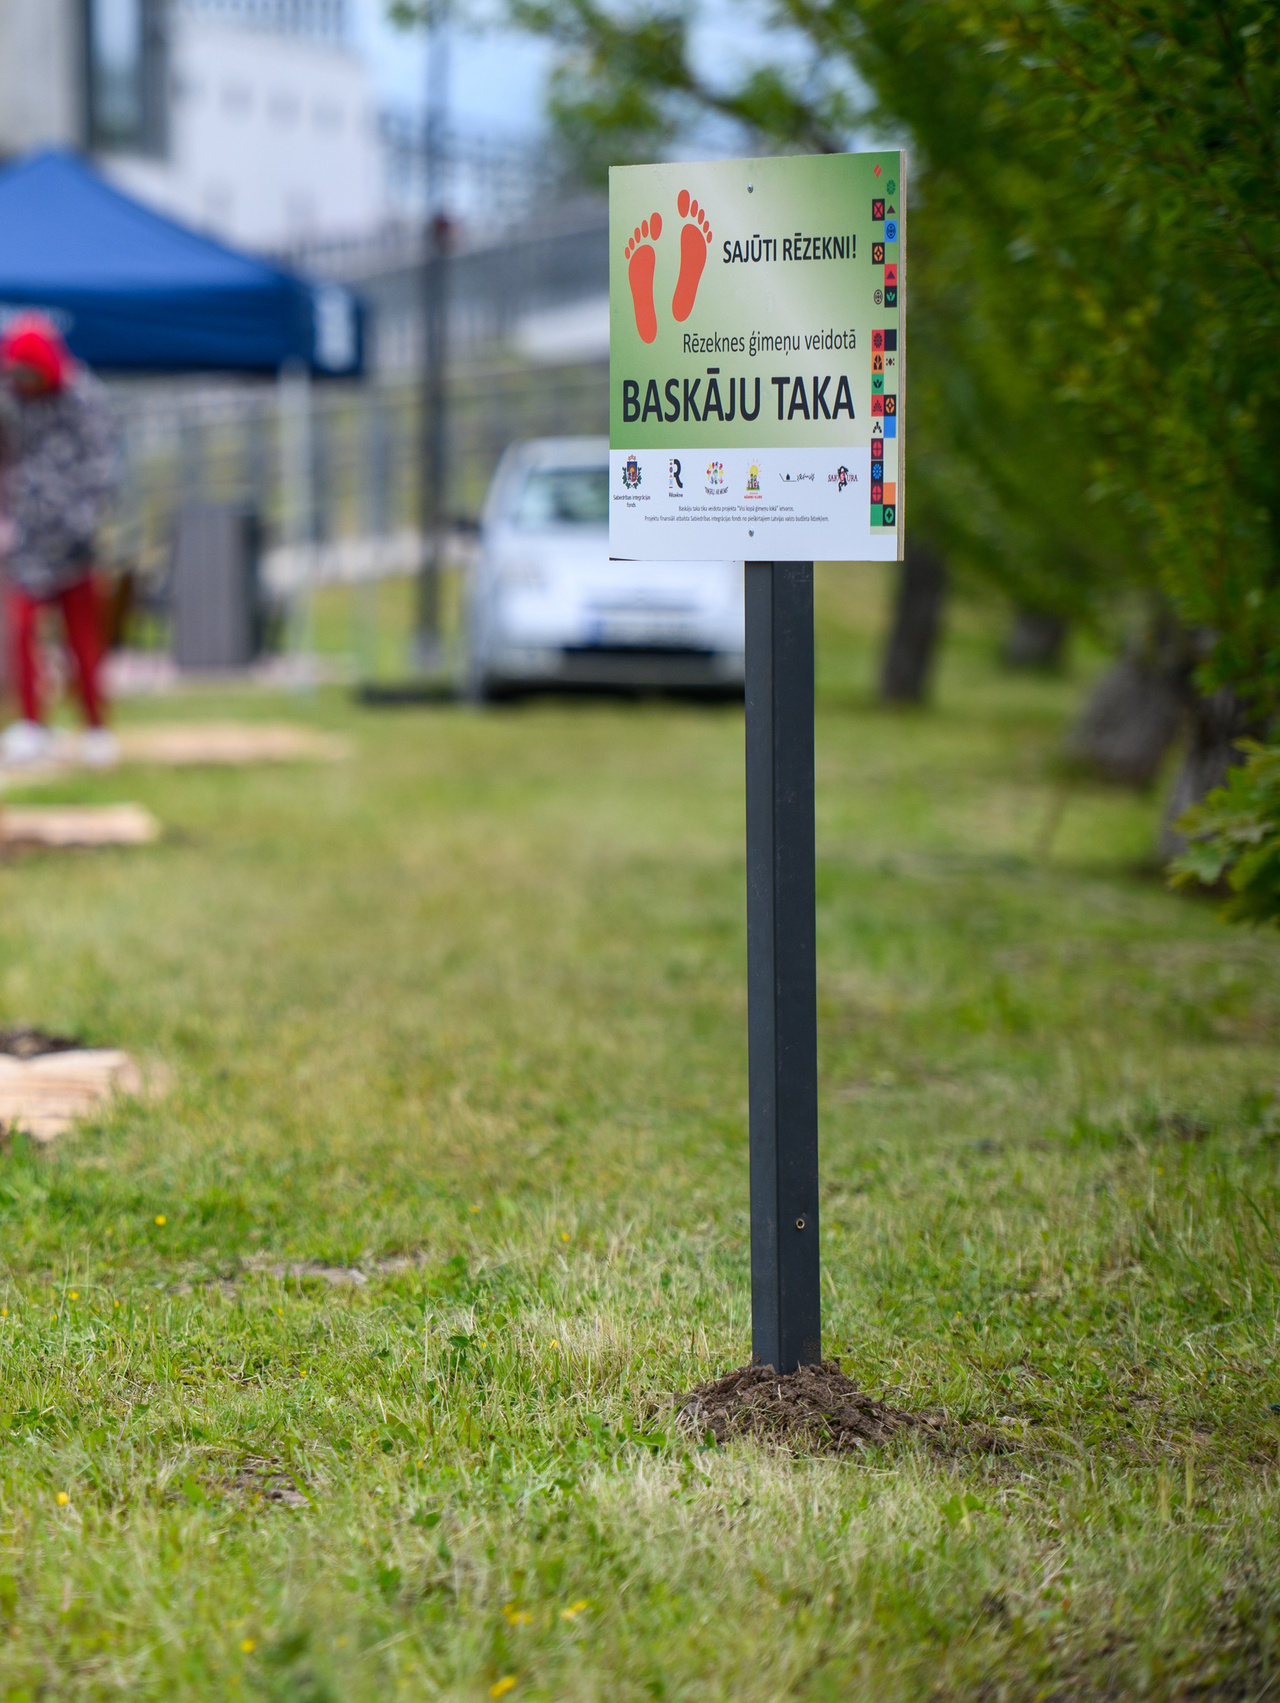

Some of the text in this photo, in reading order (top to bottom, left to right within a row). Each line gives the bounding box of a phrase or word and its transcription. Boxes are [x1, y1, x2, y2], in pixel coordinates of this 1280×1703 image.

[722, 232, 857, 263] SAJŪTI RĒZEKNI!
[683, 328, 856, 356] Rēzeknes ģimeņu veidotā
[622, 367, 856, 423] BASKĀJU TAKA
